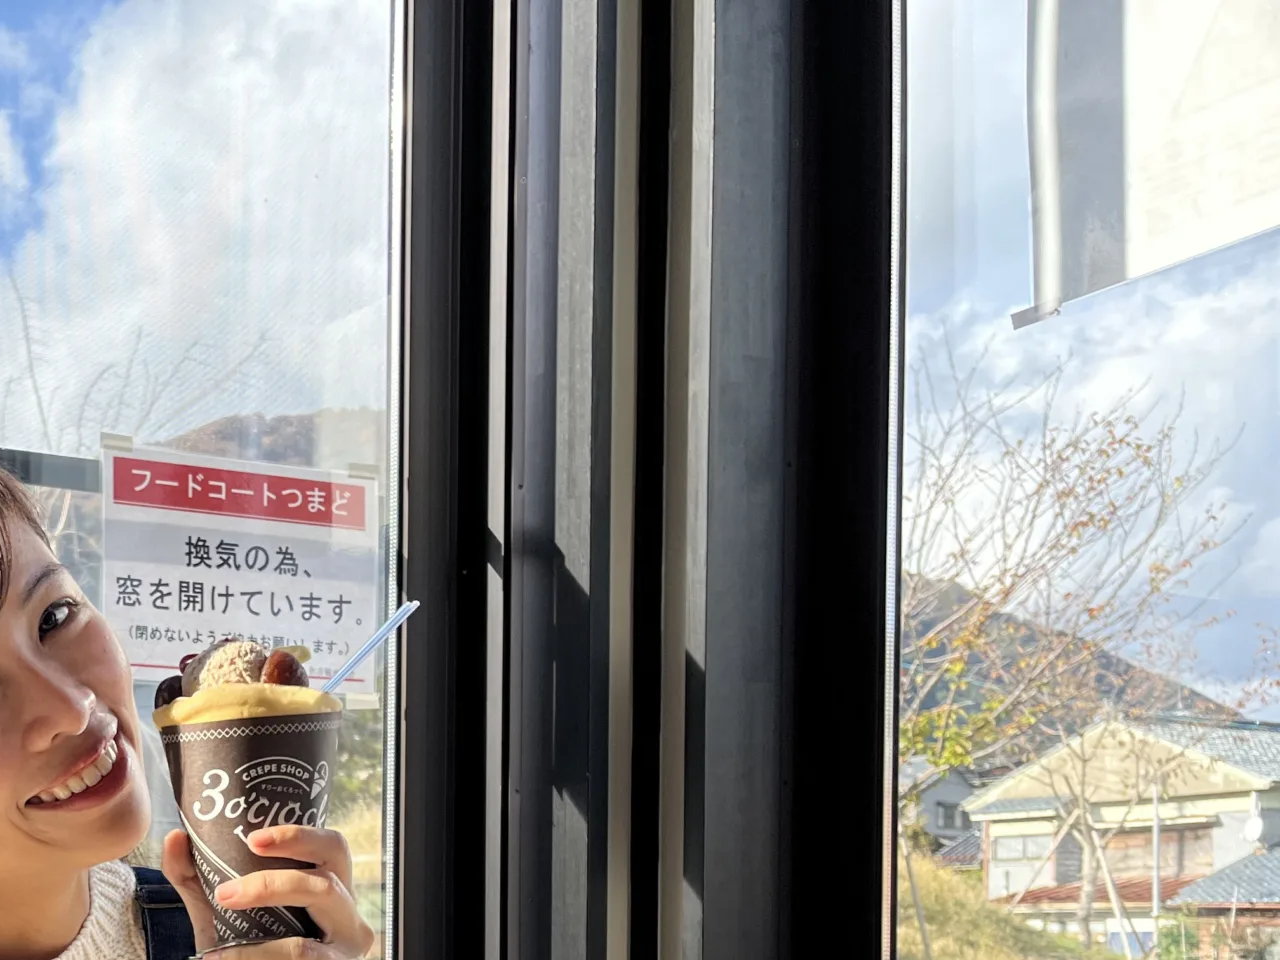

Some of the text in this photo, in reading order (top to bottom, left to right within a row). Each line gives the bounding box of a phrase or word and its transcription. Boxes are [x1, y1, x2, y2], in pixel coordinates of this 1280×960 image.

[131, 468, 351, 516] フードコートつまど
[185, 536, 312, 578] 換気の為、
[116, 574, 363, 625] 窓を開けています。
[242, 763, 310, 781] CREPE SHOP
[246, 907, 287, 936] ELCREAM
